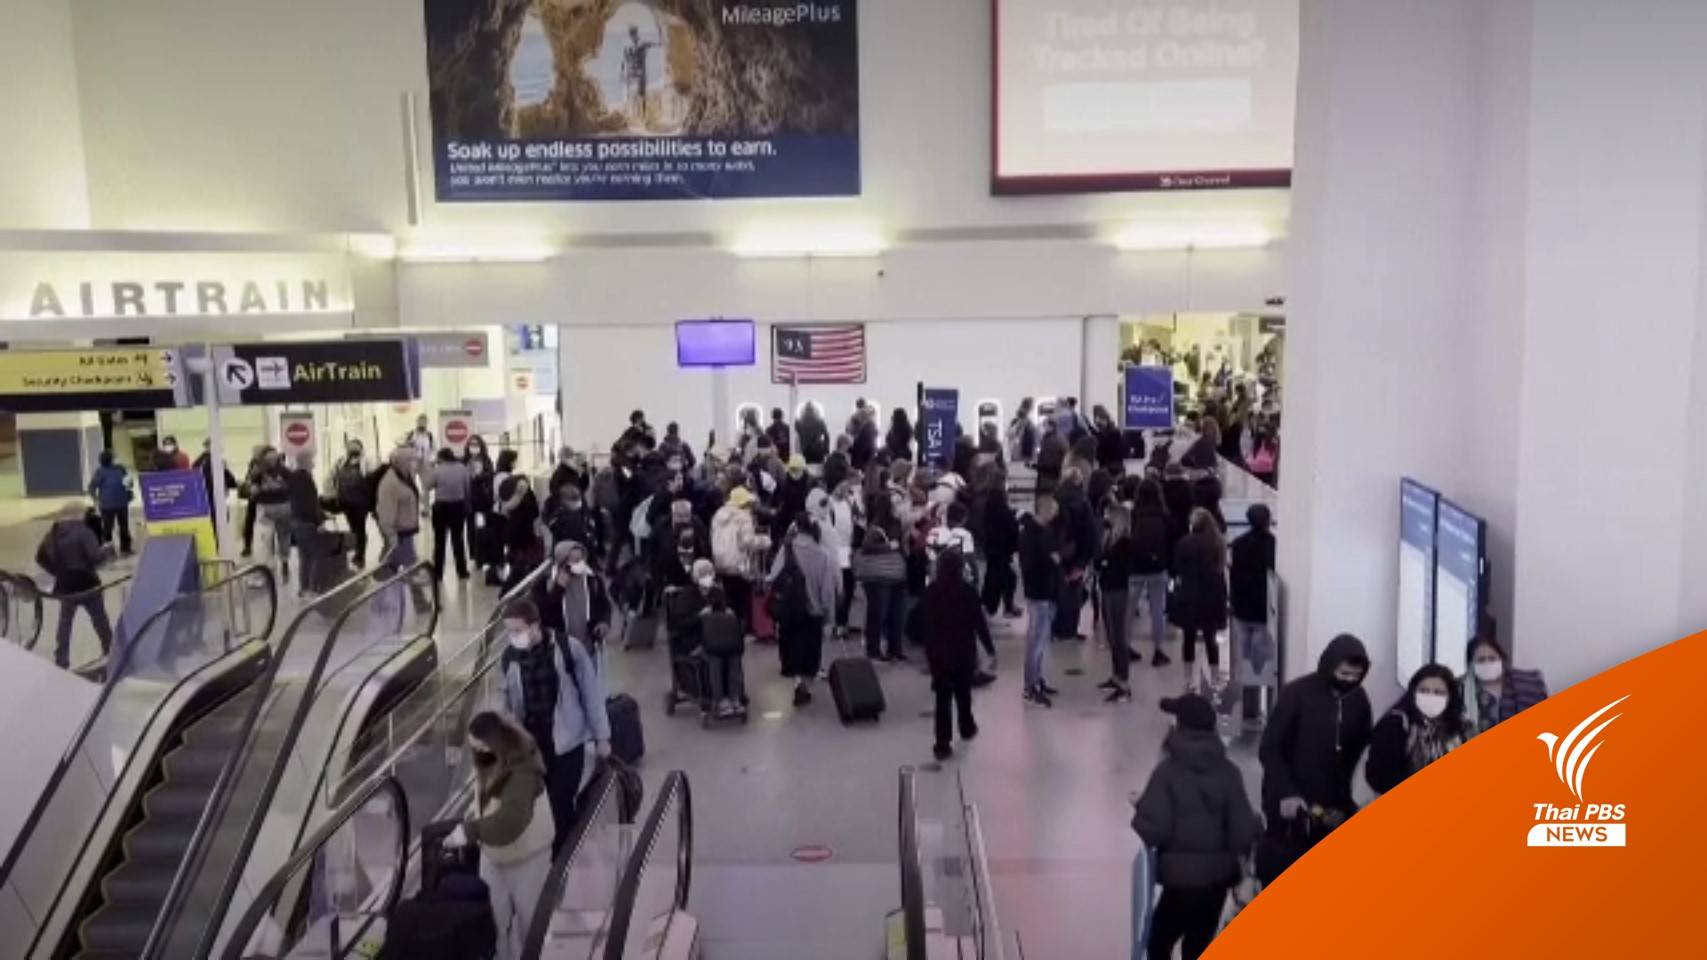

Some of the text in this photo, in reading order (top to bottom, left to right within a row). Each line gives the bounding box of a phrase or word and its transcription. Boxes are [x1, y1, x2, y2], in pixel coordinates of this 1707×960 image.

[722, 2, 842, 27] MileagePlus
[1125, 8, 1163, 36] Of
[1167, 6, 1256, 40] Being
[1027, 41, 1148, 72] Tracked
[447, 138, 777, 160] Soak up endless possibilities to earn.
[29, 280, 330, 317] AIRTRAIN
[292, 360, 383, 382] AirTrain
[927, 417, 943, 449] TSA
